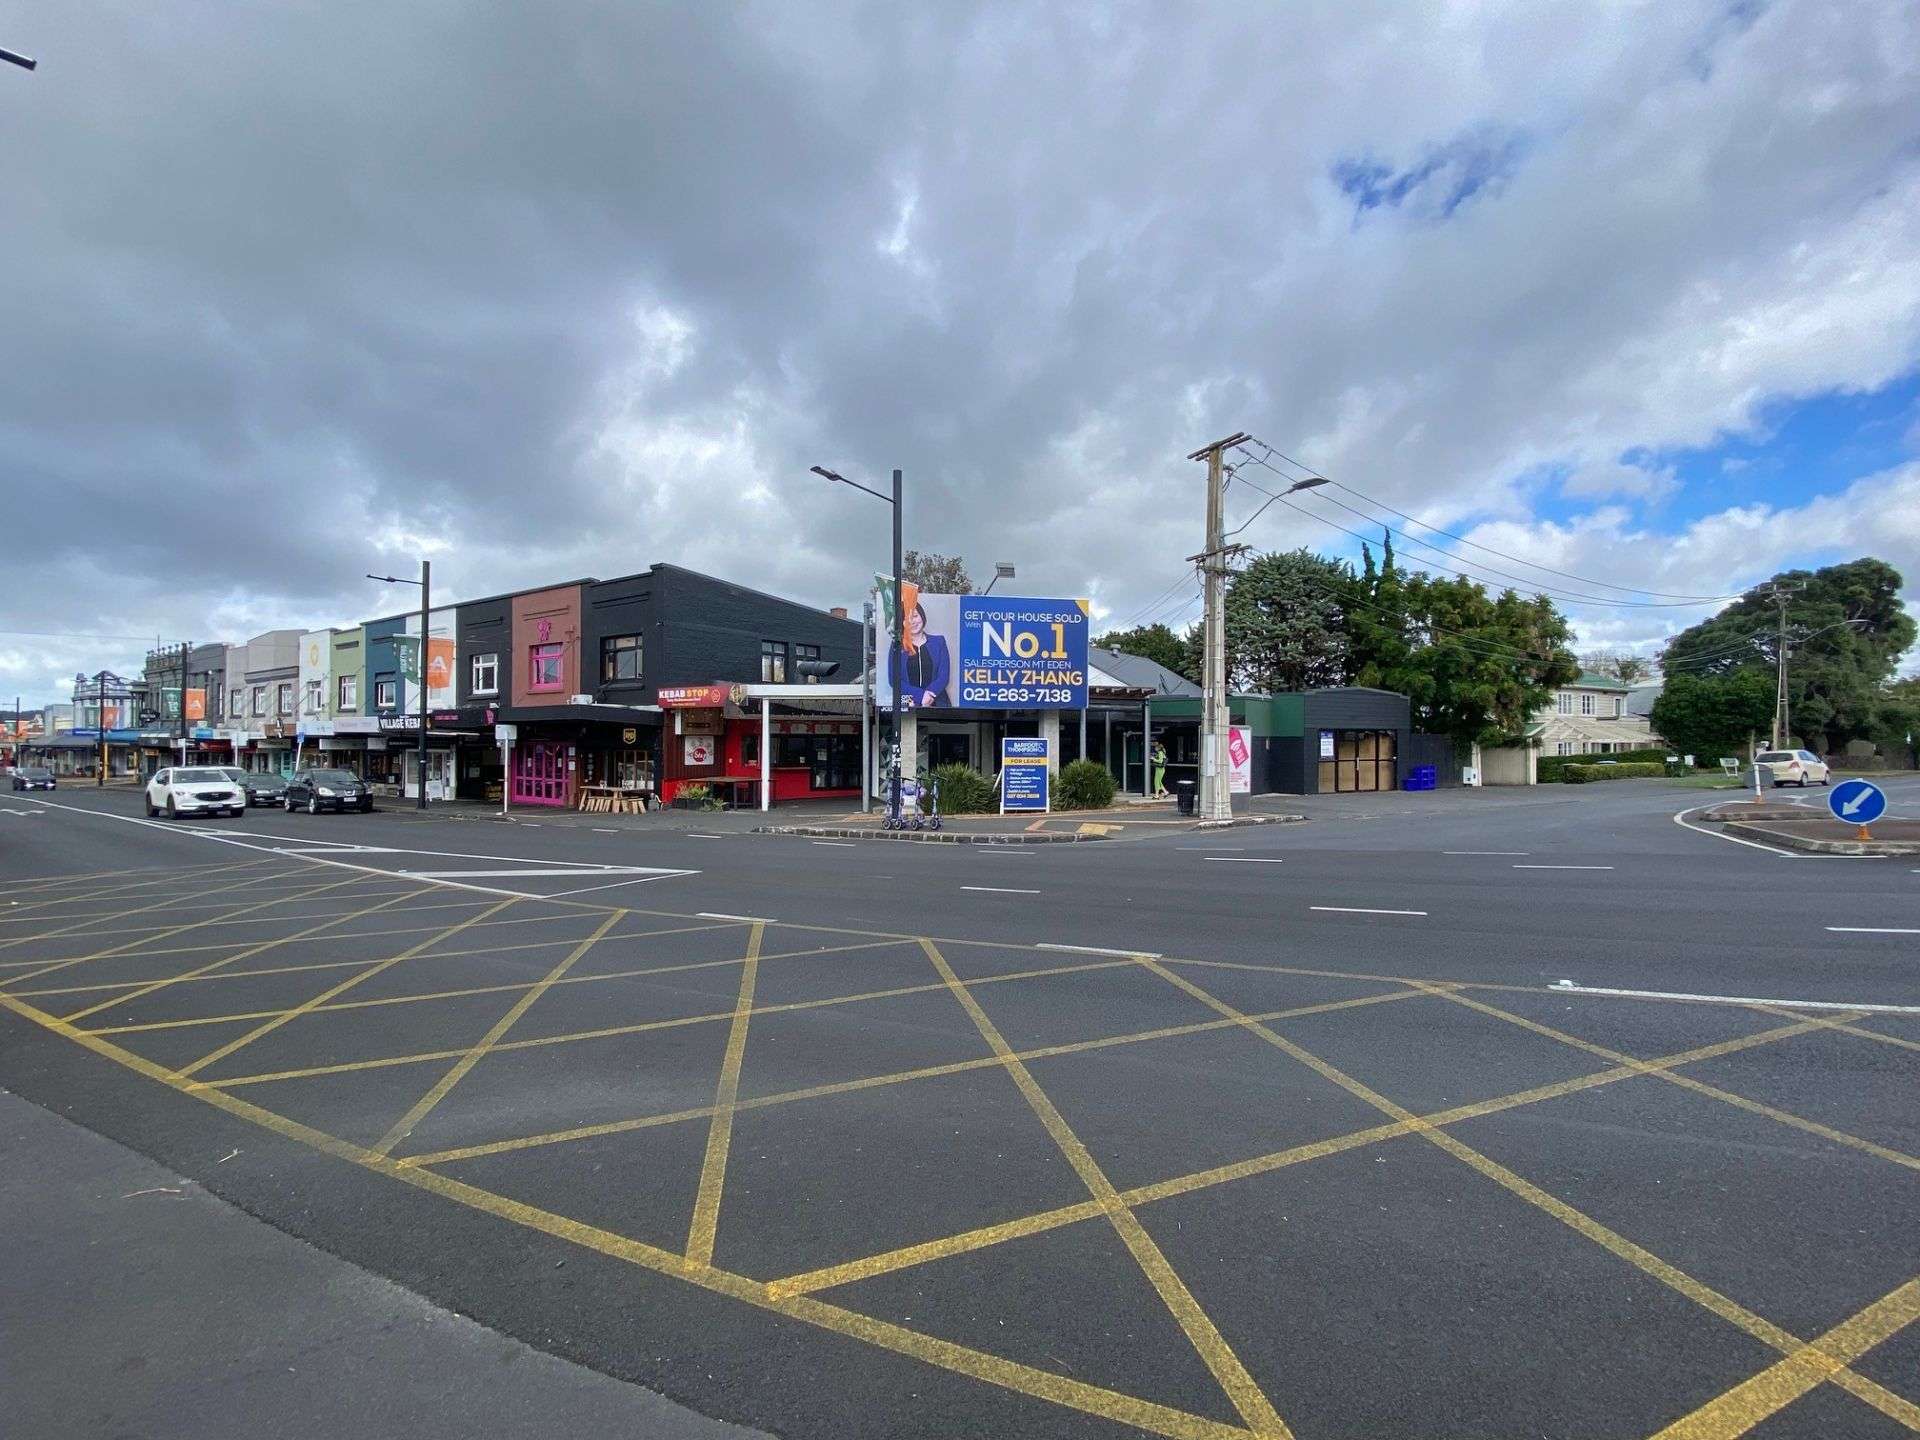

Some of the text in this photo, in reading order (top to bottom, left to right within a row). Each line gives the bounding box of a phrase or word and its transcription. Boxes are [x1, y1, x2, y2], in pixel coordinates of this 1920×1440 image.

[964, 611, 1082, 623] GET YOUR HOUSE SOLD
[982, 621, 1068, 659] No.1
[964, 659, 1072, 669] SALESPERSON MT EDEN
[964, 669, 1083, 685] KELLY ZHANG
[658, 688, 709, 699] KEBAB STOP
[963, 687, 1072, 703] 021-263-7138
[380, 718, 404, 729] VILLAGE
